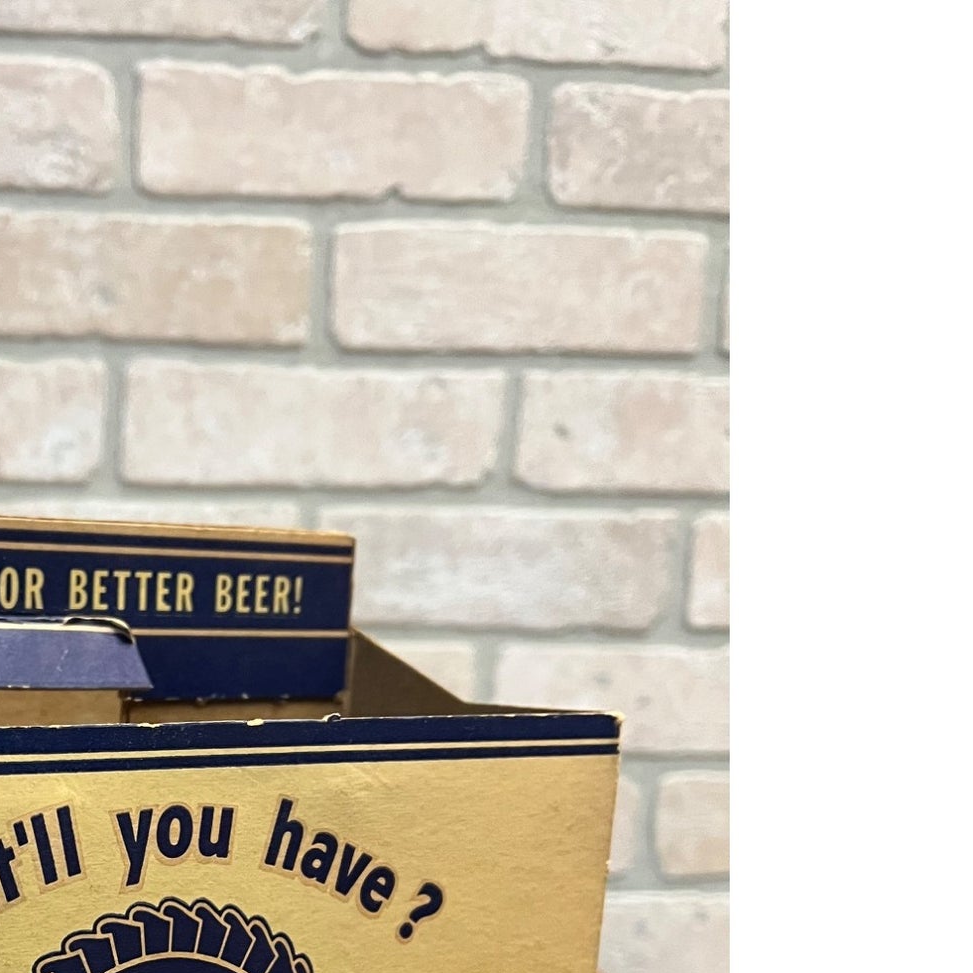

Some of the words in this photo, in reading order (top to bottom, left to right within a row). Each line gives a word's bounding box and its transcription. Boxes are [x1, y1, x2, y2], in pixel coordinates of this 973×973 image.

[68, 569, 195, 613] BETTER
[214, 574, 304, 615] BEER!
[115, 804, 236, 887] you
